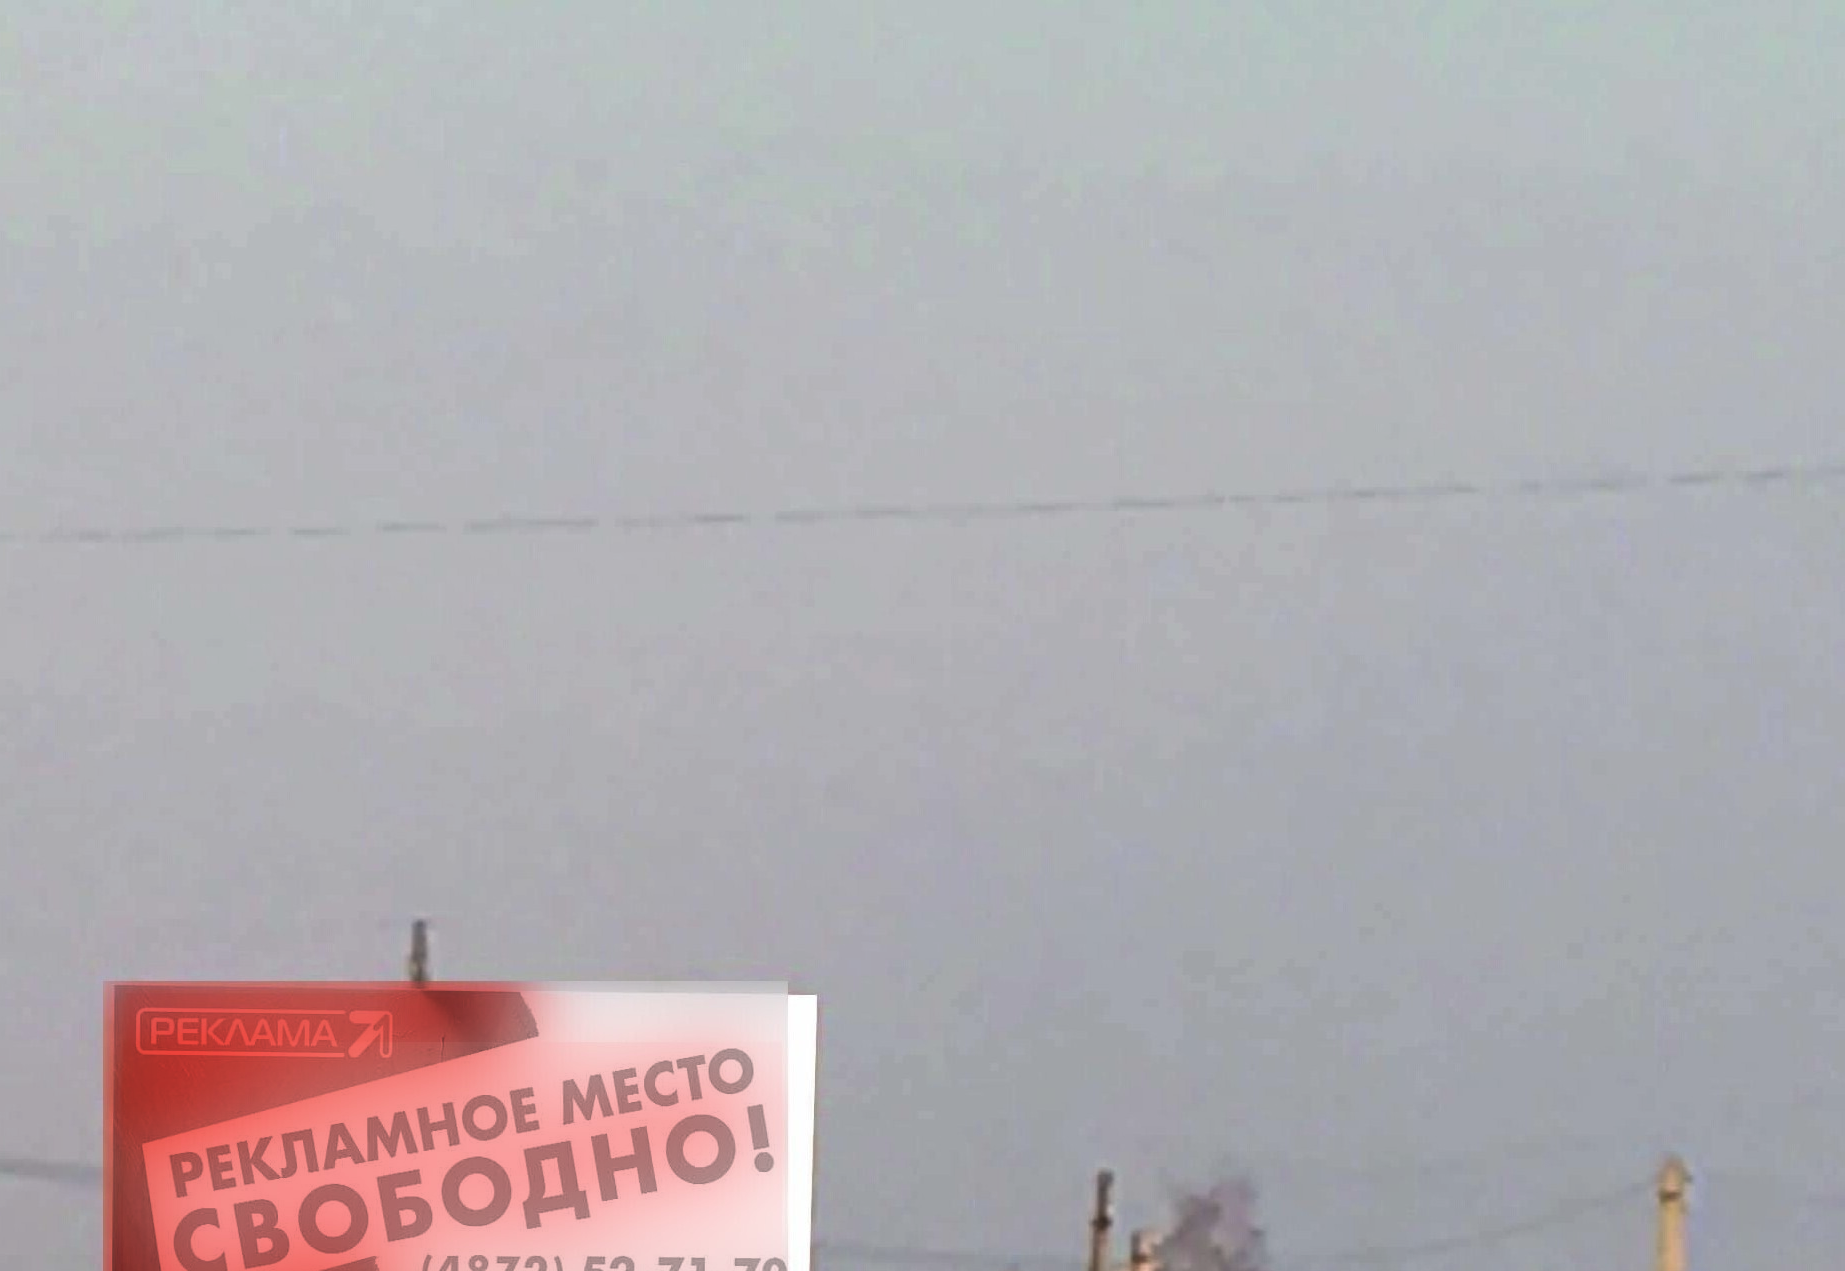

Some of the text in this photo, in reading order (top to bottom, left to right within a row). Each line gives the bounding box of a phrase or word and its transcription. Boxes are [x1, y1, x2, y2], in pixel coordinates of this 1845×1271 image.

[150, 1017, 338, 1047] РЕКЛАМА
[169, 1048, 755, 1198] РЕКЛАМНОЕ МЕСТО
